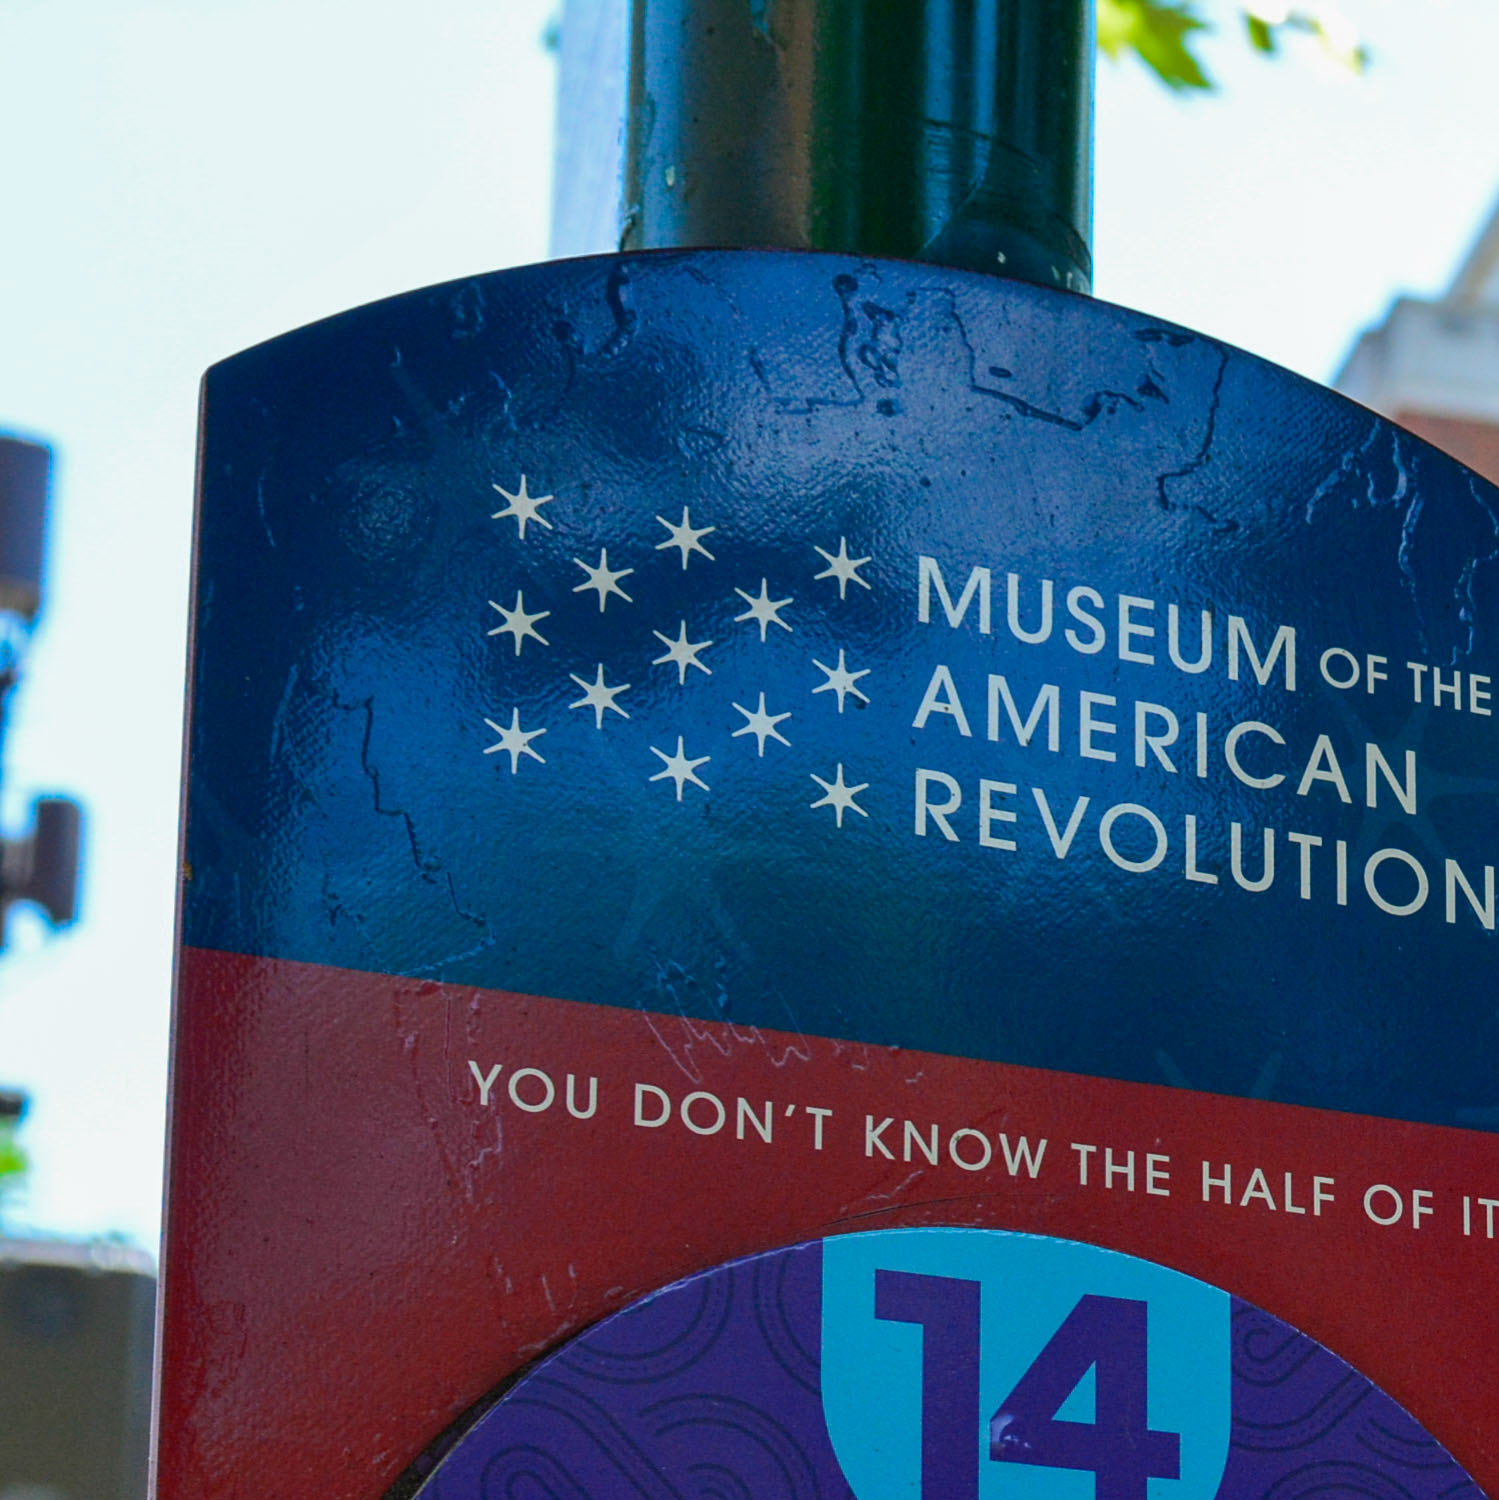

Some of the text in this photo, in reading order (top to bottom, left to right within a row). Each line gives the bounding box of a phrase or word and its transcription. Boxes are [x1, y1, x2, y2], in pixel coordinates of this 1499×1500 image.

[916, 555, 1492, 716] MUSEUM OF THE
[913, 663, 1418, 816] AMERICAN
[913, 769, 1497, 930] REVOLUTION
[468, 1060, 599, 1121] YOU
[865, 1117, 1046, 1180] KNOW
[1071, 1144, 1171, 1197] THE
[1204, 1161, 1334, 1217] HALF
[1363, 1182, 1434, 1229] OF
